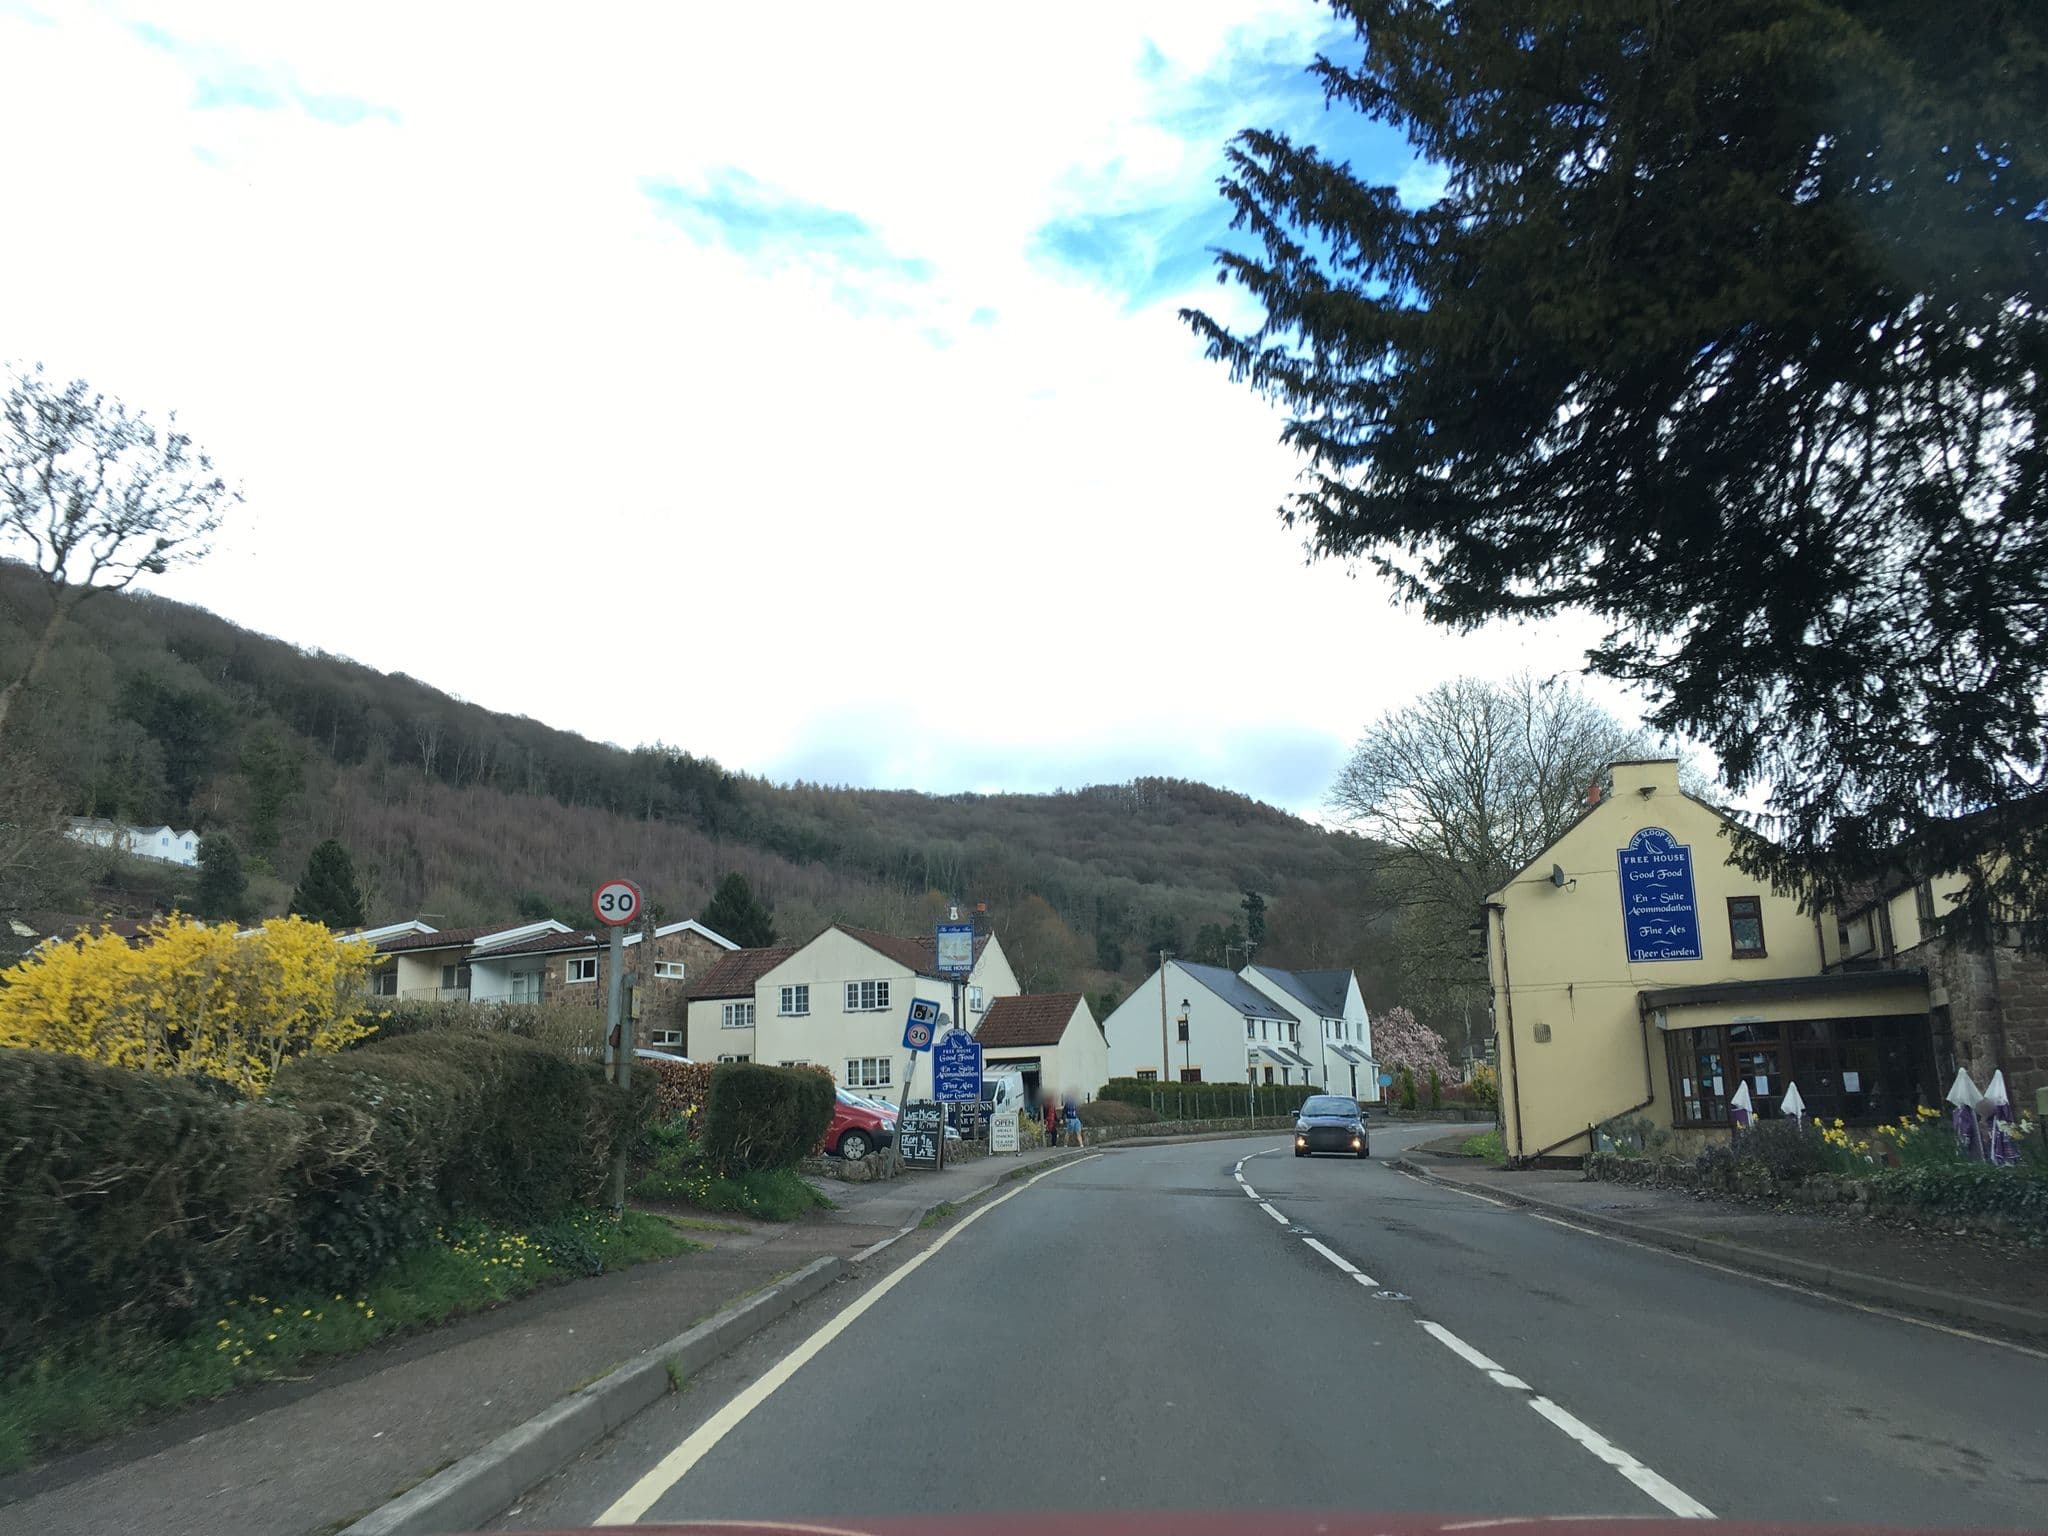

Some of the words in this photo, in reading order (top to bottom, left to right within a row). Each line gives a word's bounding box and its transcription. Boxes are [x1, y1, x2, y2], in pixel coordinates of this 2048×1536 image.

[1631, 836, 1642, 851] THE
[1641, 829, 1665, 839] SLOOP
[1664, 836, 1675, 849] INN
[1624, 856, 1649, 864] FREE
[1653, 853, 1685, 863] HOUSE
[1629, 869, 1655, 881] Good
[1656, 868, 1683, 880] Food
[600, 893, 633, 912] 30
[1632, 893, 1648, 903] En
[1660, 892, 1684, 904] Suite
[1628, 903, 1692, 916] Acommodation
[1639, 926, 1662, 937] Fine
[1665, 925, 1687, 936] Ales
[1634, 948, 1658, 960] Beer
[1660, 947, 1696, 958] Garden
[911, 1029, 927, 1041] 30
[939, 1053, 957, 1062] Good
[957, 1053, 975, 1062] Food
[942, 1082, 958, 1091] Fine
[936, 1091, 954, 1100] Beer
[995, 1119, 1015, 1127] OPEN
[901, 1134, 918, 1145] FROM
